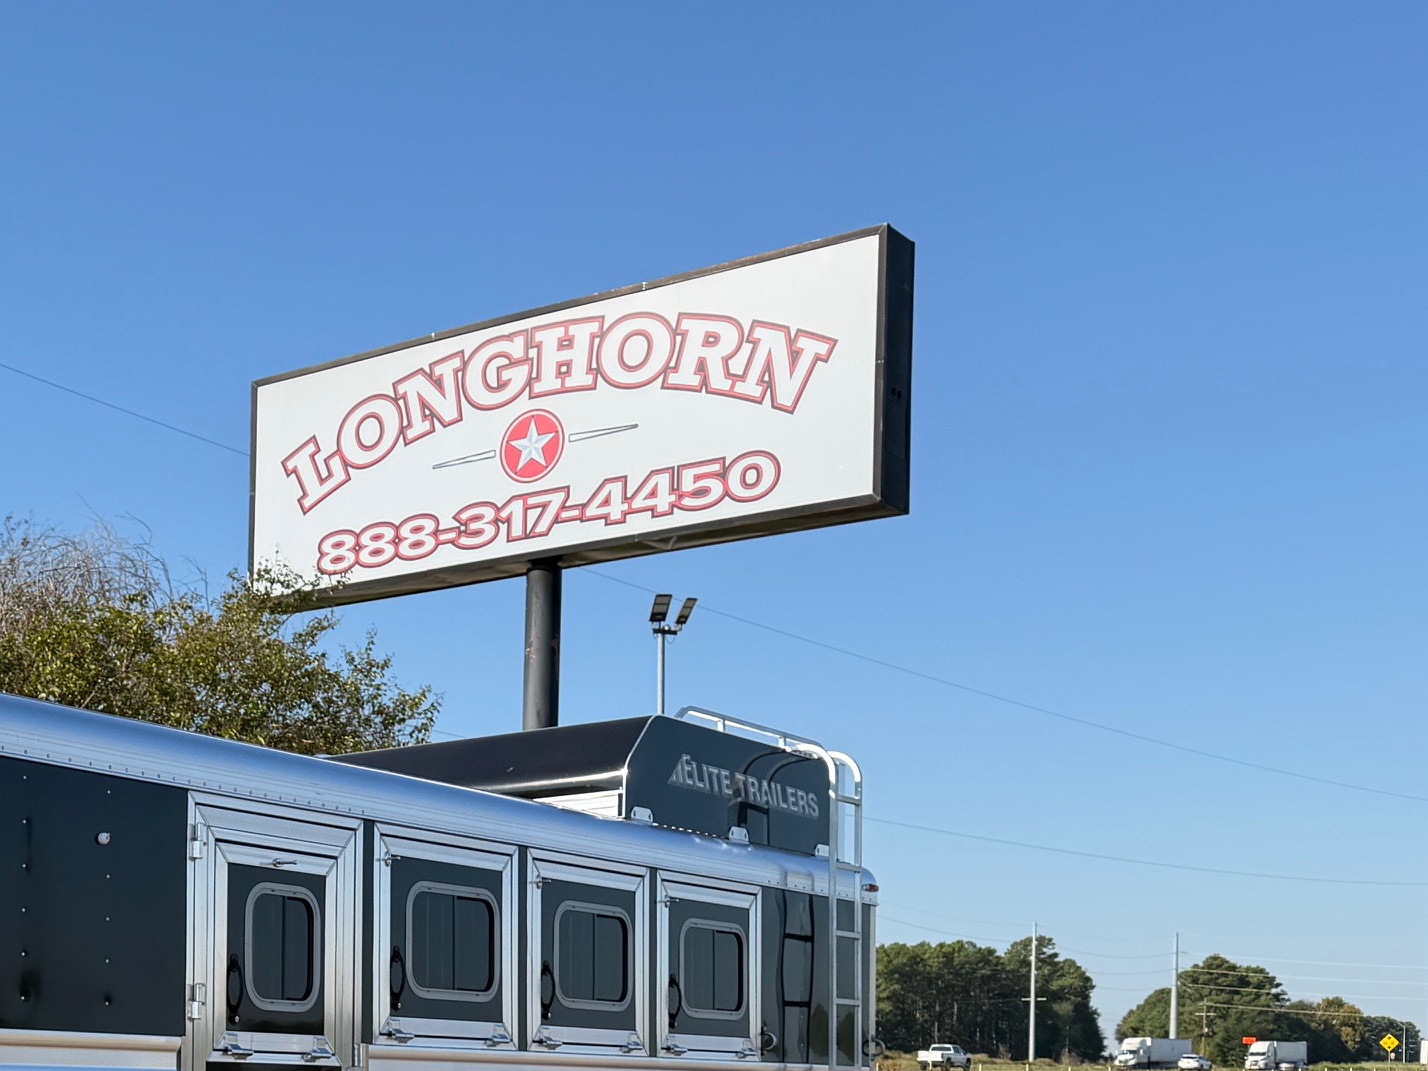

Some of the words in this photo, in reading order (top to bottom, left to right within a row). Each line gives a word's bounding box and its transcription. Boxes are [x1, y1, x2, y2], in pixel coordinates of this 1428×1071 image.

[283, 311, 837, 514] LONGHORN
[317, 450, 781, 574] 888-317-4450
[669, 754, 733, 795] ELITE
[736, 773, 820, 818] TRAILERS
